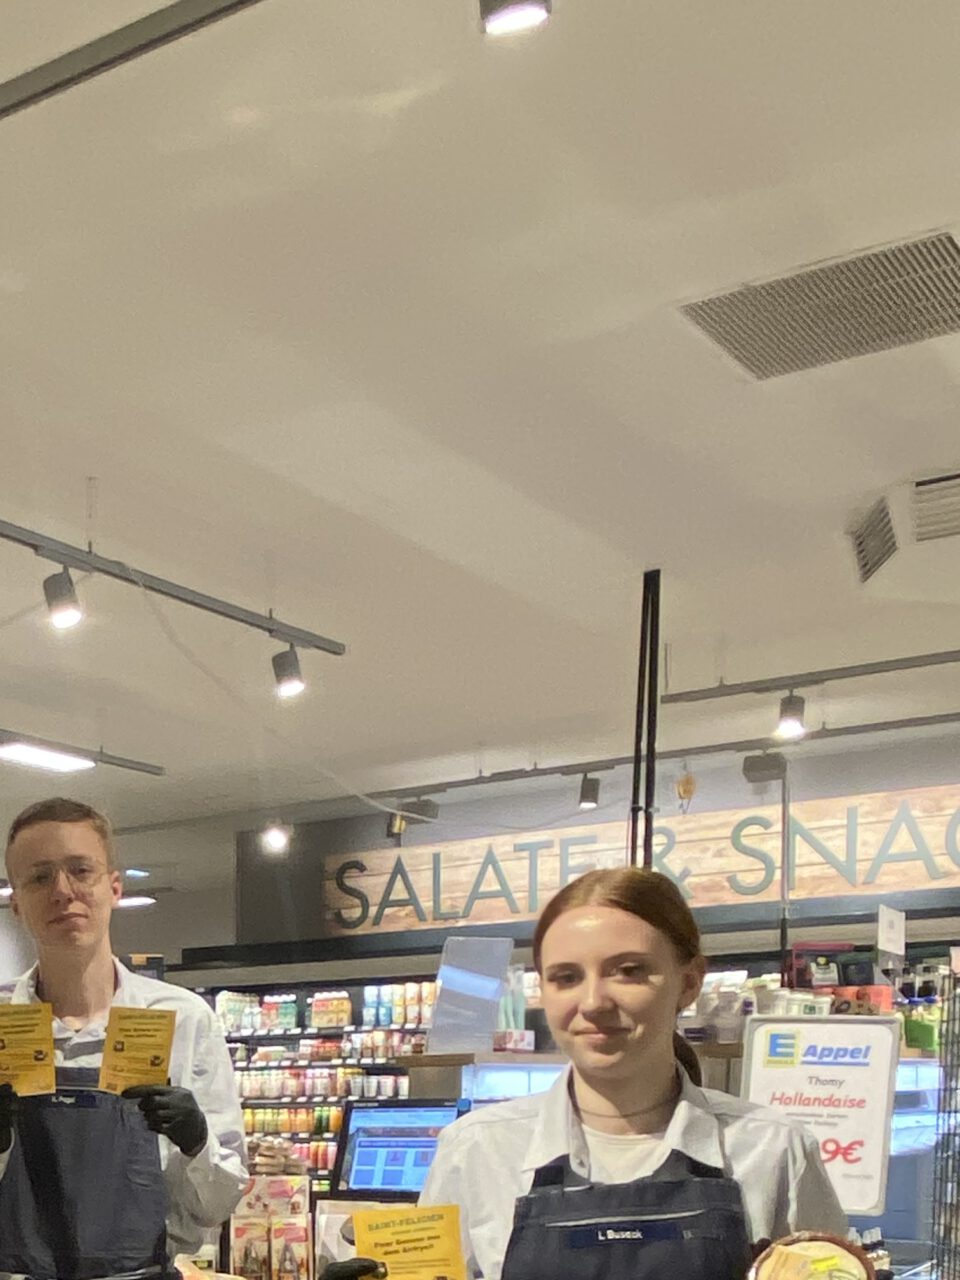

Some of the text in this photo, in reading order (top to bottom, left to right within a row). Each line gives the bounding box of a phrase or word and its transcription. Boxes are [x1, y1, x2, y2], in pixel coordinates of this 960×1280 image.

[728, 798, 960, 896] SNA
[802, 1044, 871, 1061] Appel
[807, 1075, 845, 1089] Thomy
[769, 1091, 866, 1109] Hollandaise
